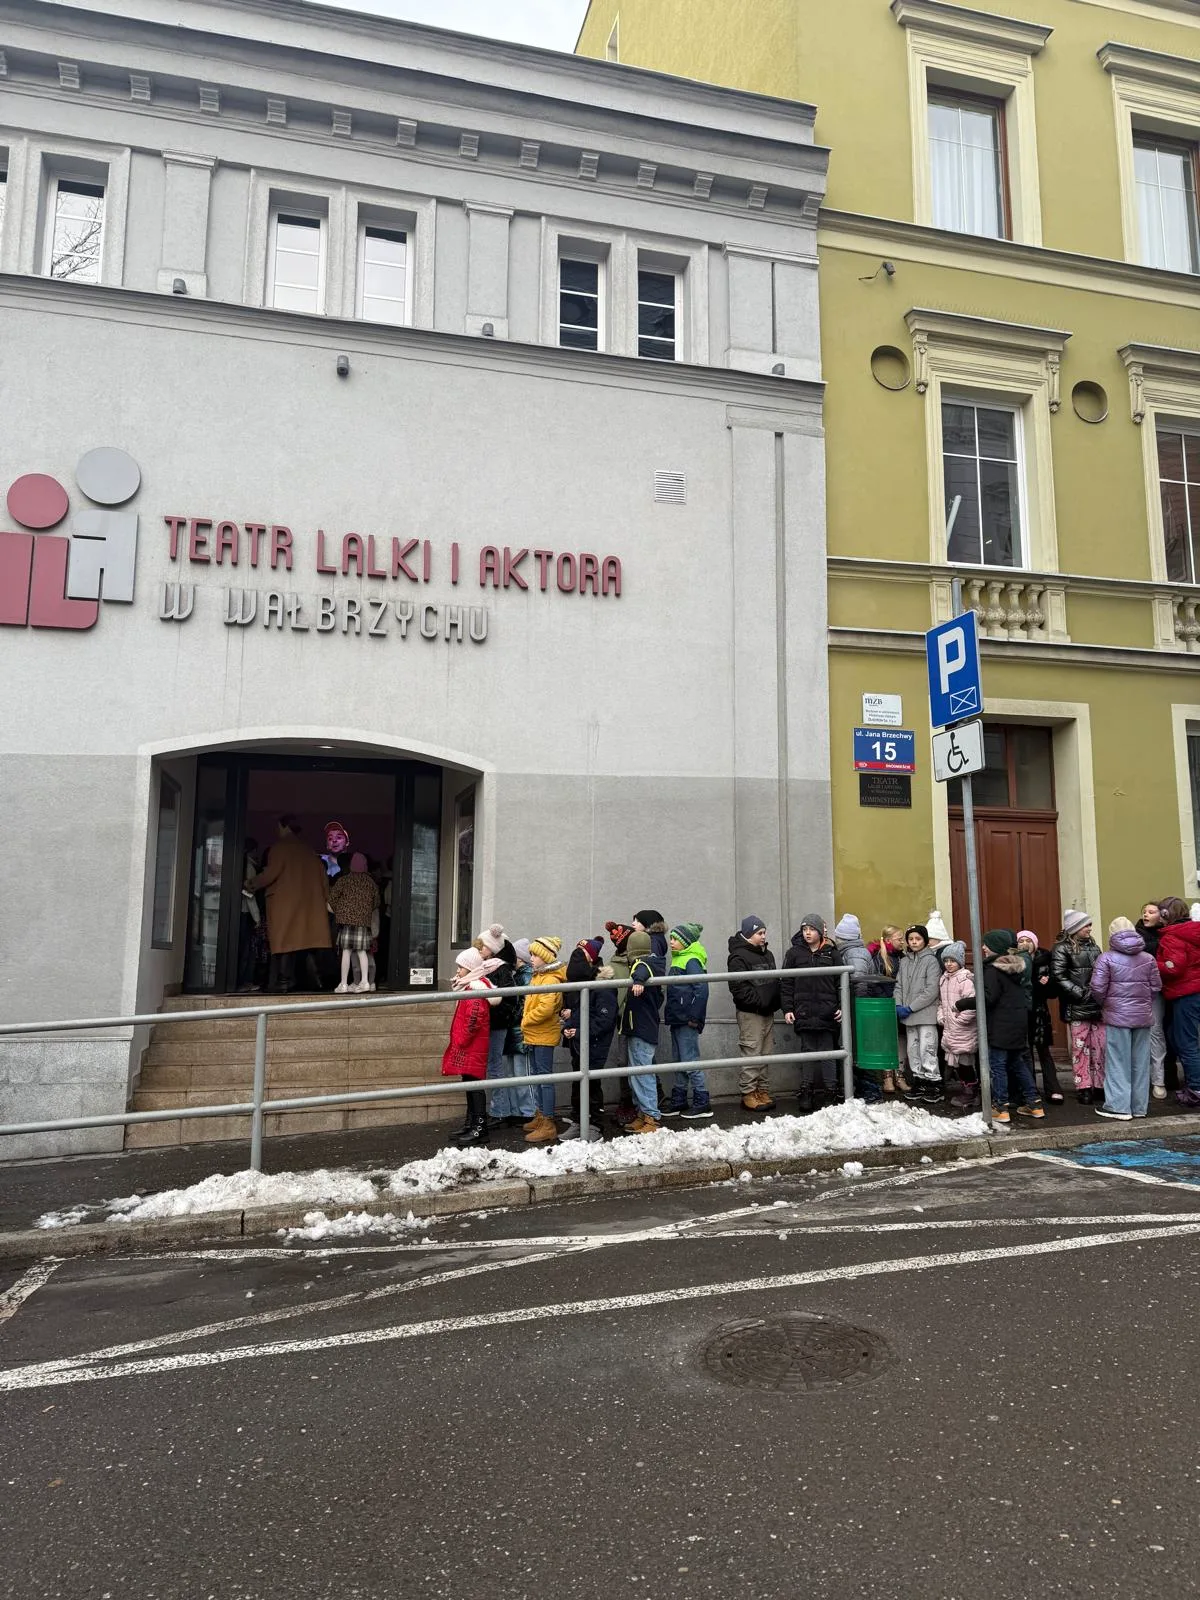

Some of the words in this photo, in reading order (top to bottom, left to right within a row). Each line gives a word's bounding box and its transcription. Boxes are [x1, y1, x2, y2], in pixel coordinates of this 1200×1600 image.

[164, 516, 293, 570] TEATR
[317, 529, 431, 583] LALKI
[452, 542, 460, 585] I
[479, 546, 622, 597] AKTORA
[159, 582, 195, 622] W
[224, 587, 490, 643] WAŁBRZYCHU
[938, 627, 967, 694] P
[871, 741, 897, 761] 15
[881, 732, 912, 741] Brzechwy
[871, 776, 899, 785] TEATR
